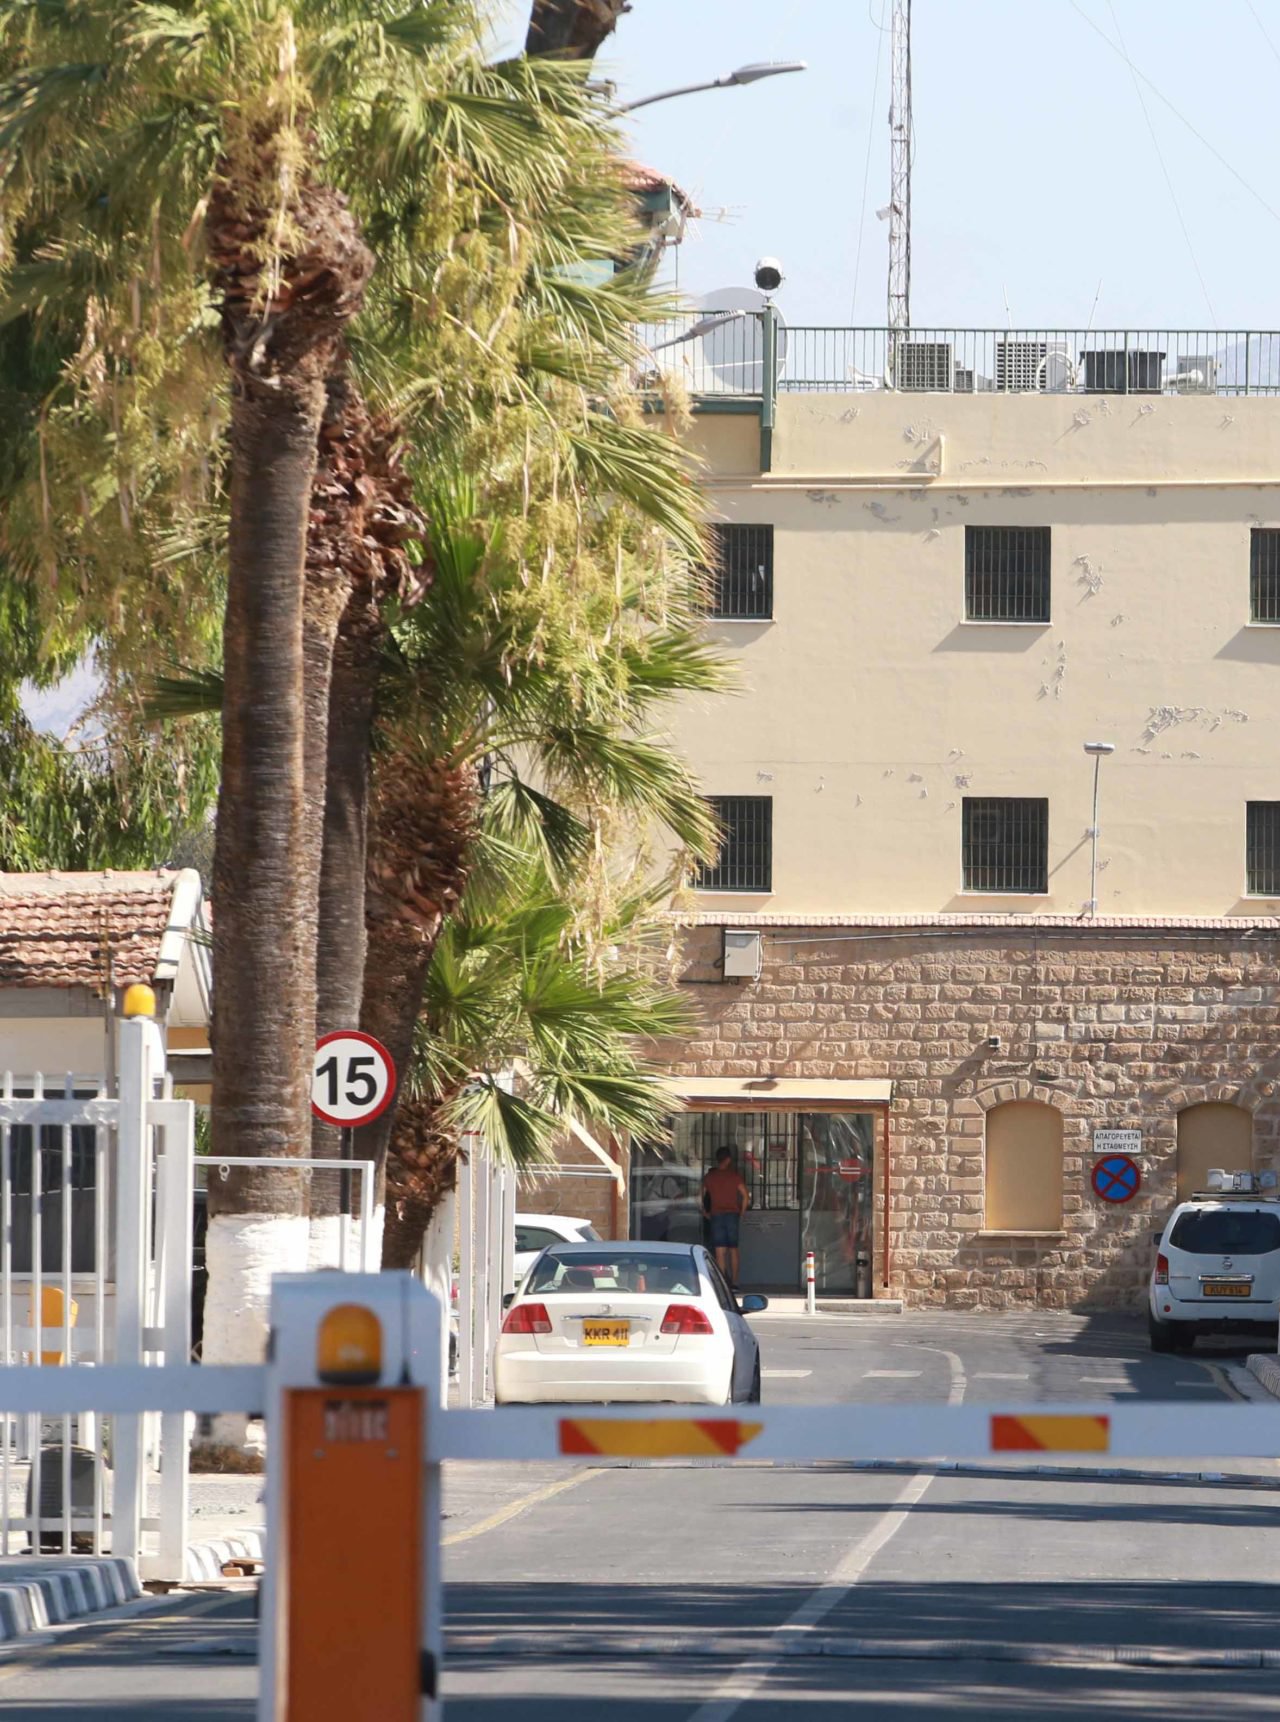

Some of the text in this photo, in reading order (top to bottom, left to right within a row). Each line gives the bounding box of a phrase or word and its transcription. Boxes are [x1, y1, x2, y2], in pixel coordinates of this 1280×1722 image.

[316, 1056, 377, 1106] 15
[1103, 1142, 1138, 1150] ΣΤΑΘΜΕΥΣΗ
[585, 1328, 628, 1340] KKR 411
